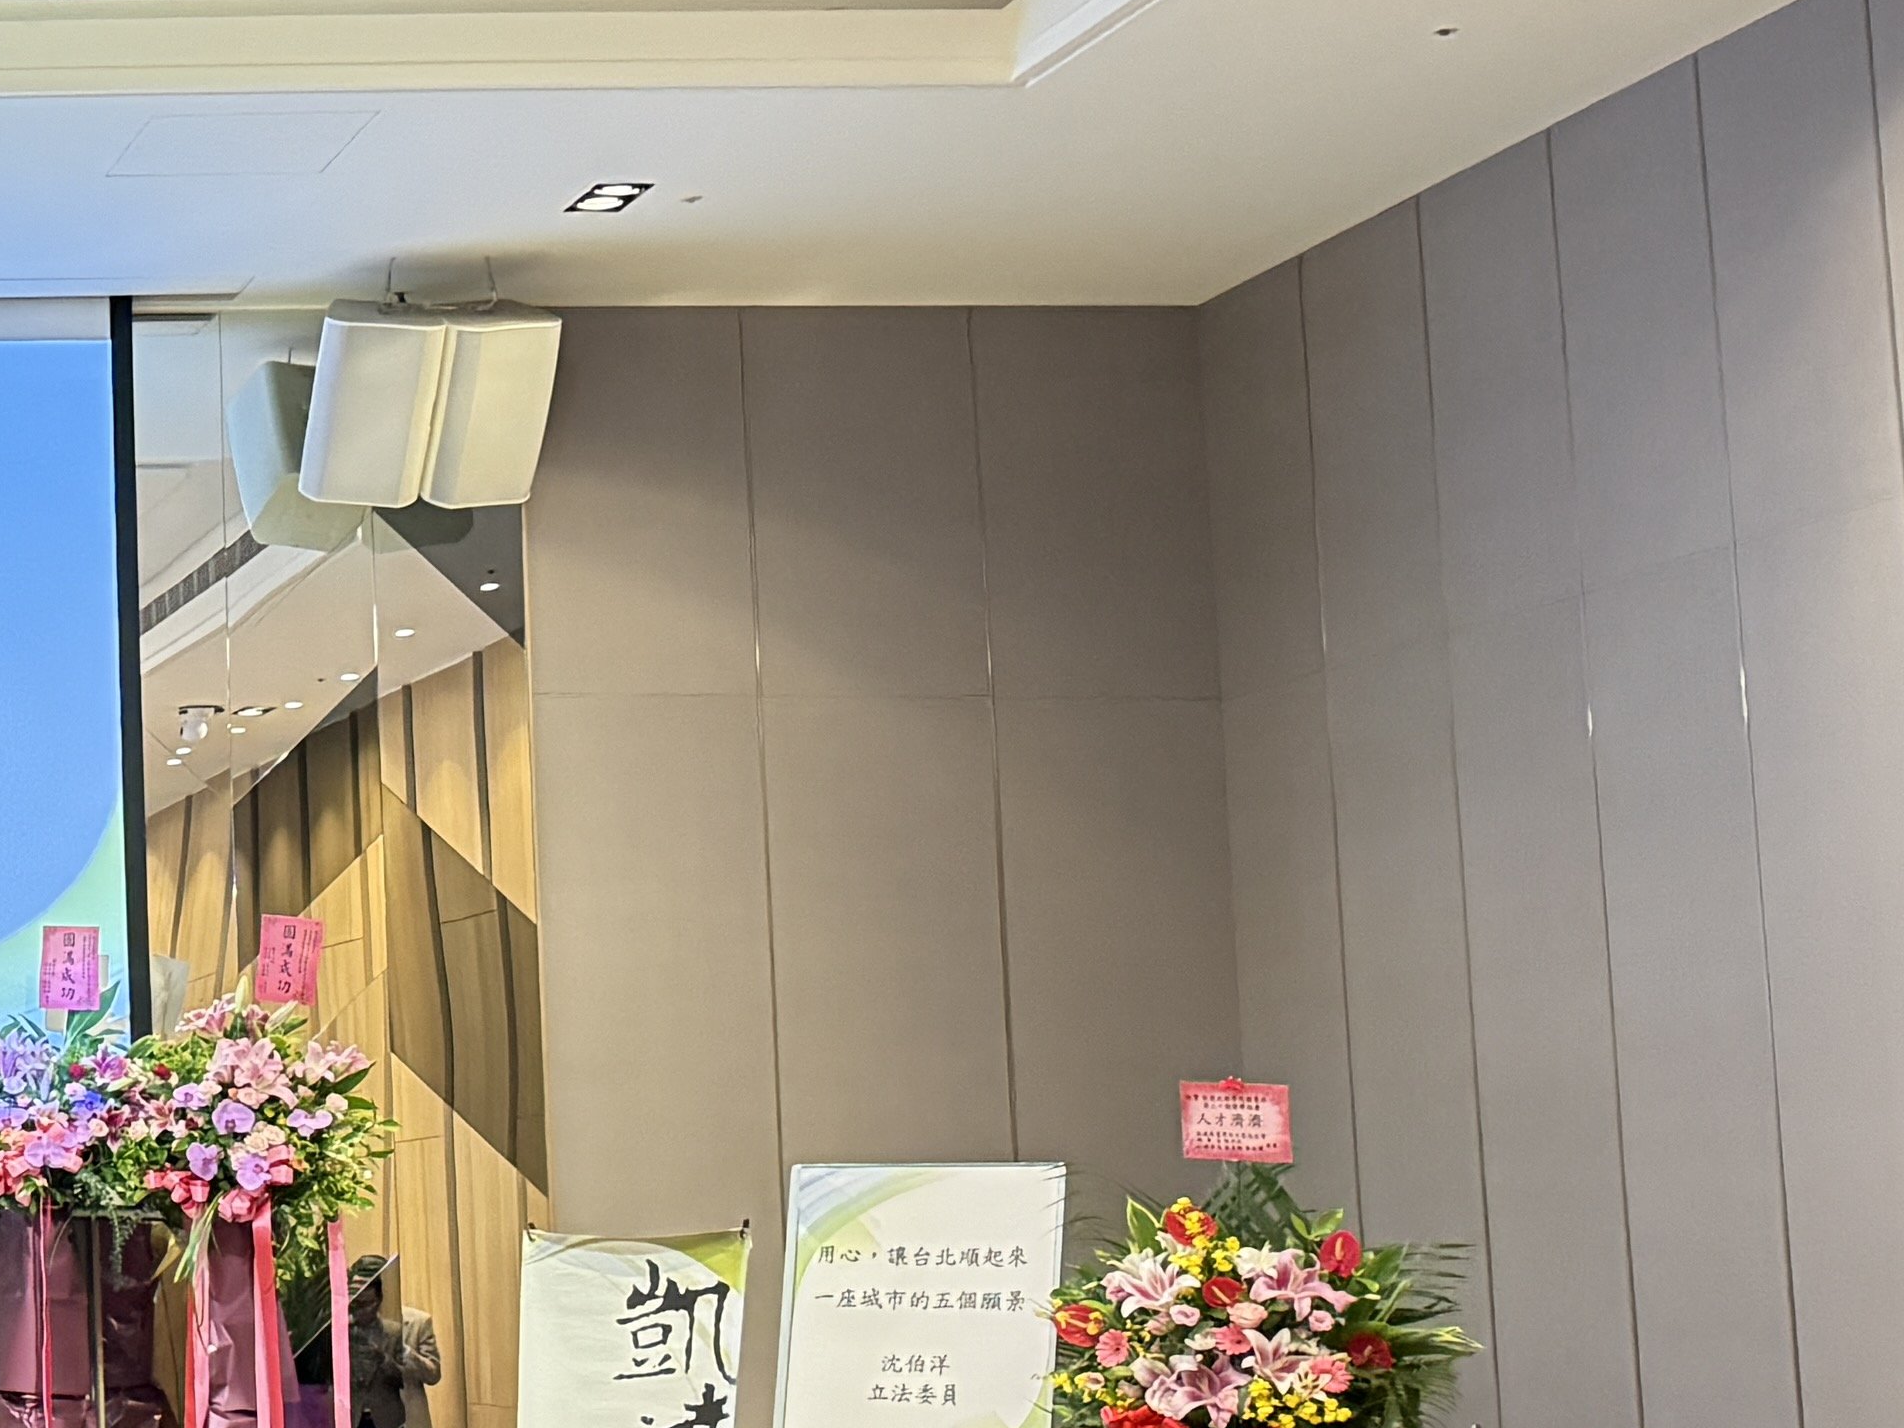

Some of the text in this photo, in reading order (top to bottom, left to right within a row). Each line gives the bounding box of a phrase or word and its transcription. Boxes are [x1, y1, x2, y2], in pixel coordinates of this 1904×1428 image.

[814, 1288, 1026, 1313] 一座城市的五個願景
[881, 1354, 951, 1376] 沈伯洋
[867, 1383, 958, 1407] 立法委員
